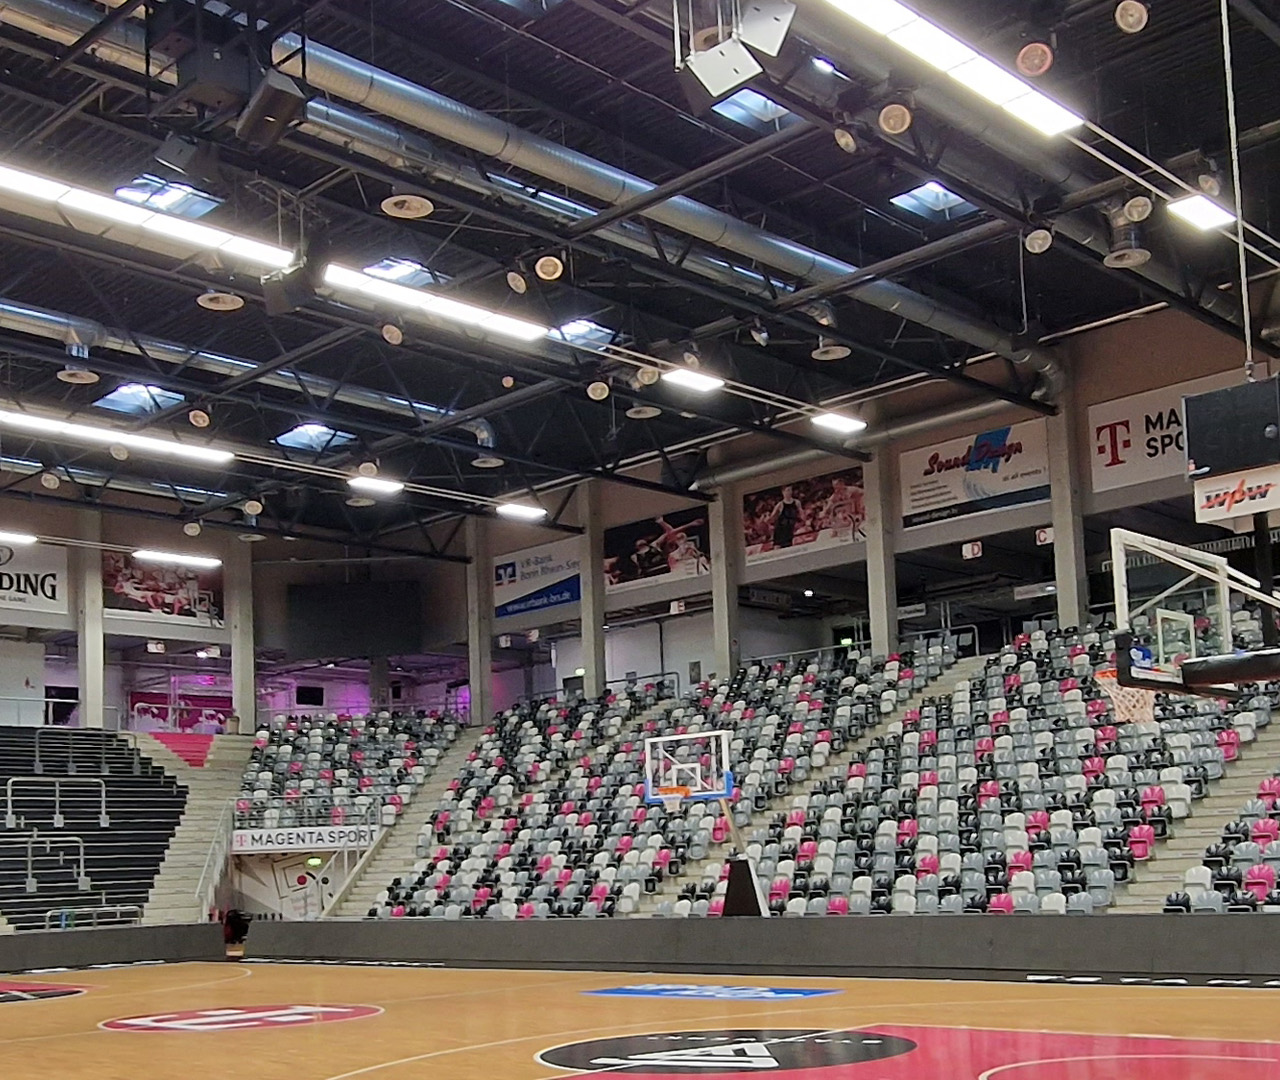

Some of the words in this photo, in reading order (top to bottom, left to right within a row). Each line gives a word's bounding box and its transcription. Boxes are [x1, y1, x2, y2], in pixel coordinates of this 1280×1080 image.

[1144, 407, 1183, 434] MA
[1145, 433, 1183, 457] SPO
[922, 446, 972, 476] Sound
[1038, 530, 1047, 543] C
[971, 543, 981, 556] D
[251, 831, 325, 847] MAGENTA
[328, 829, 376, 844] SPORT
